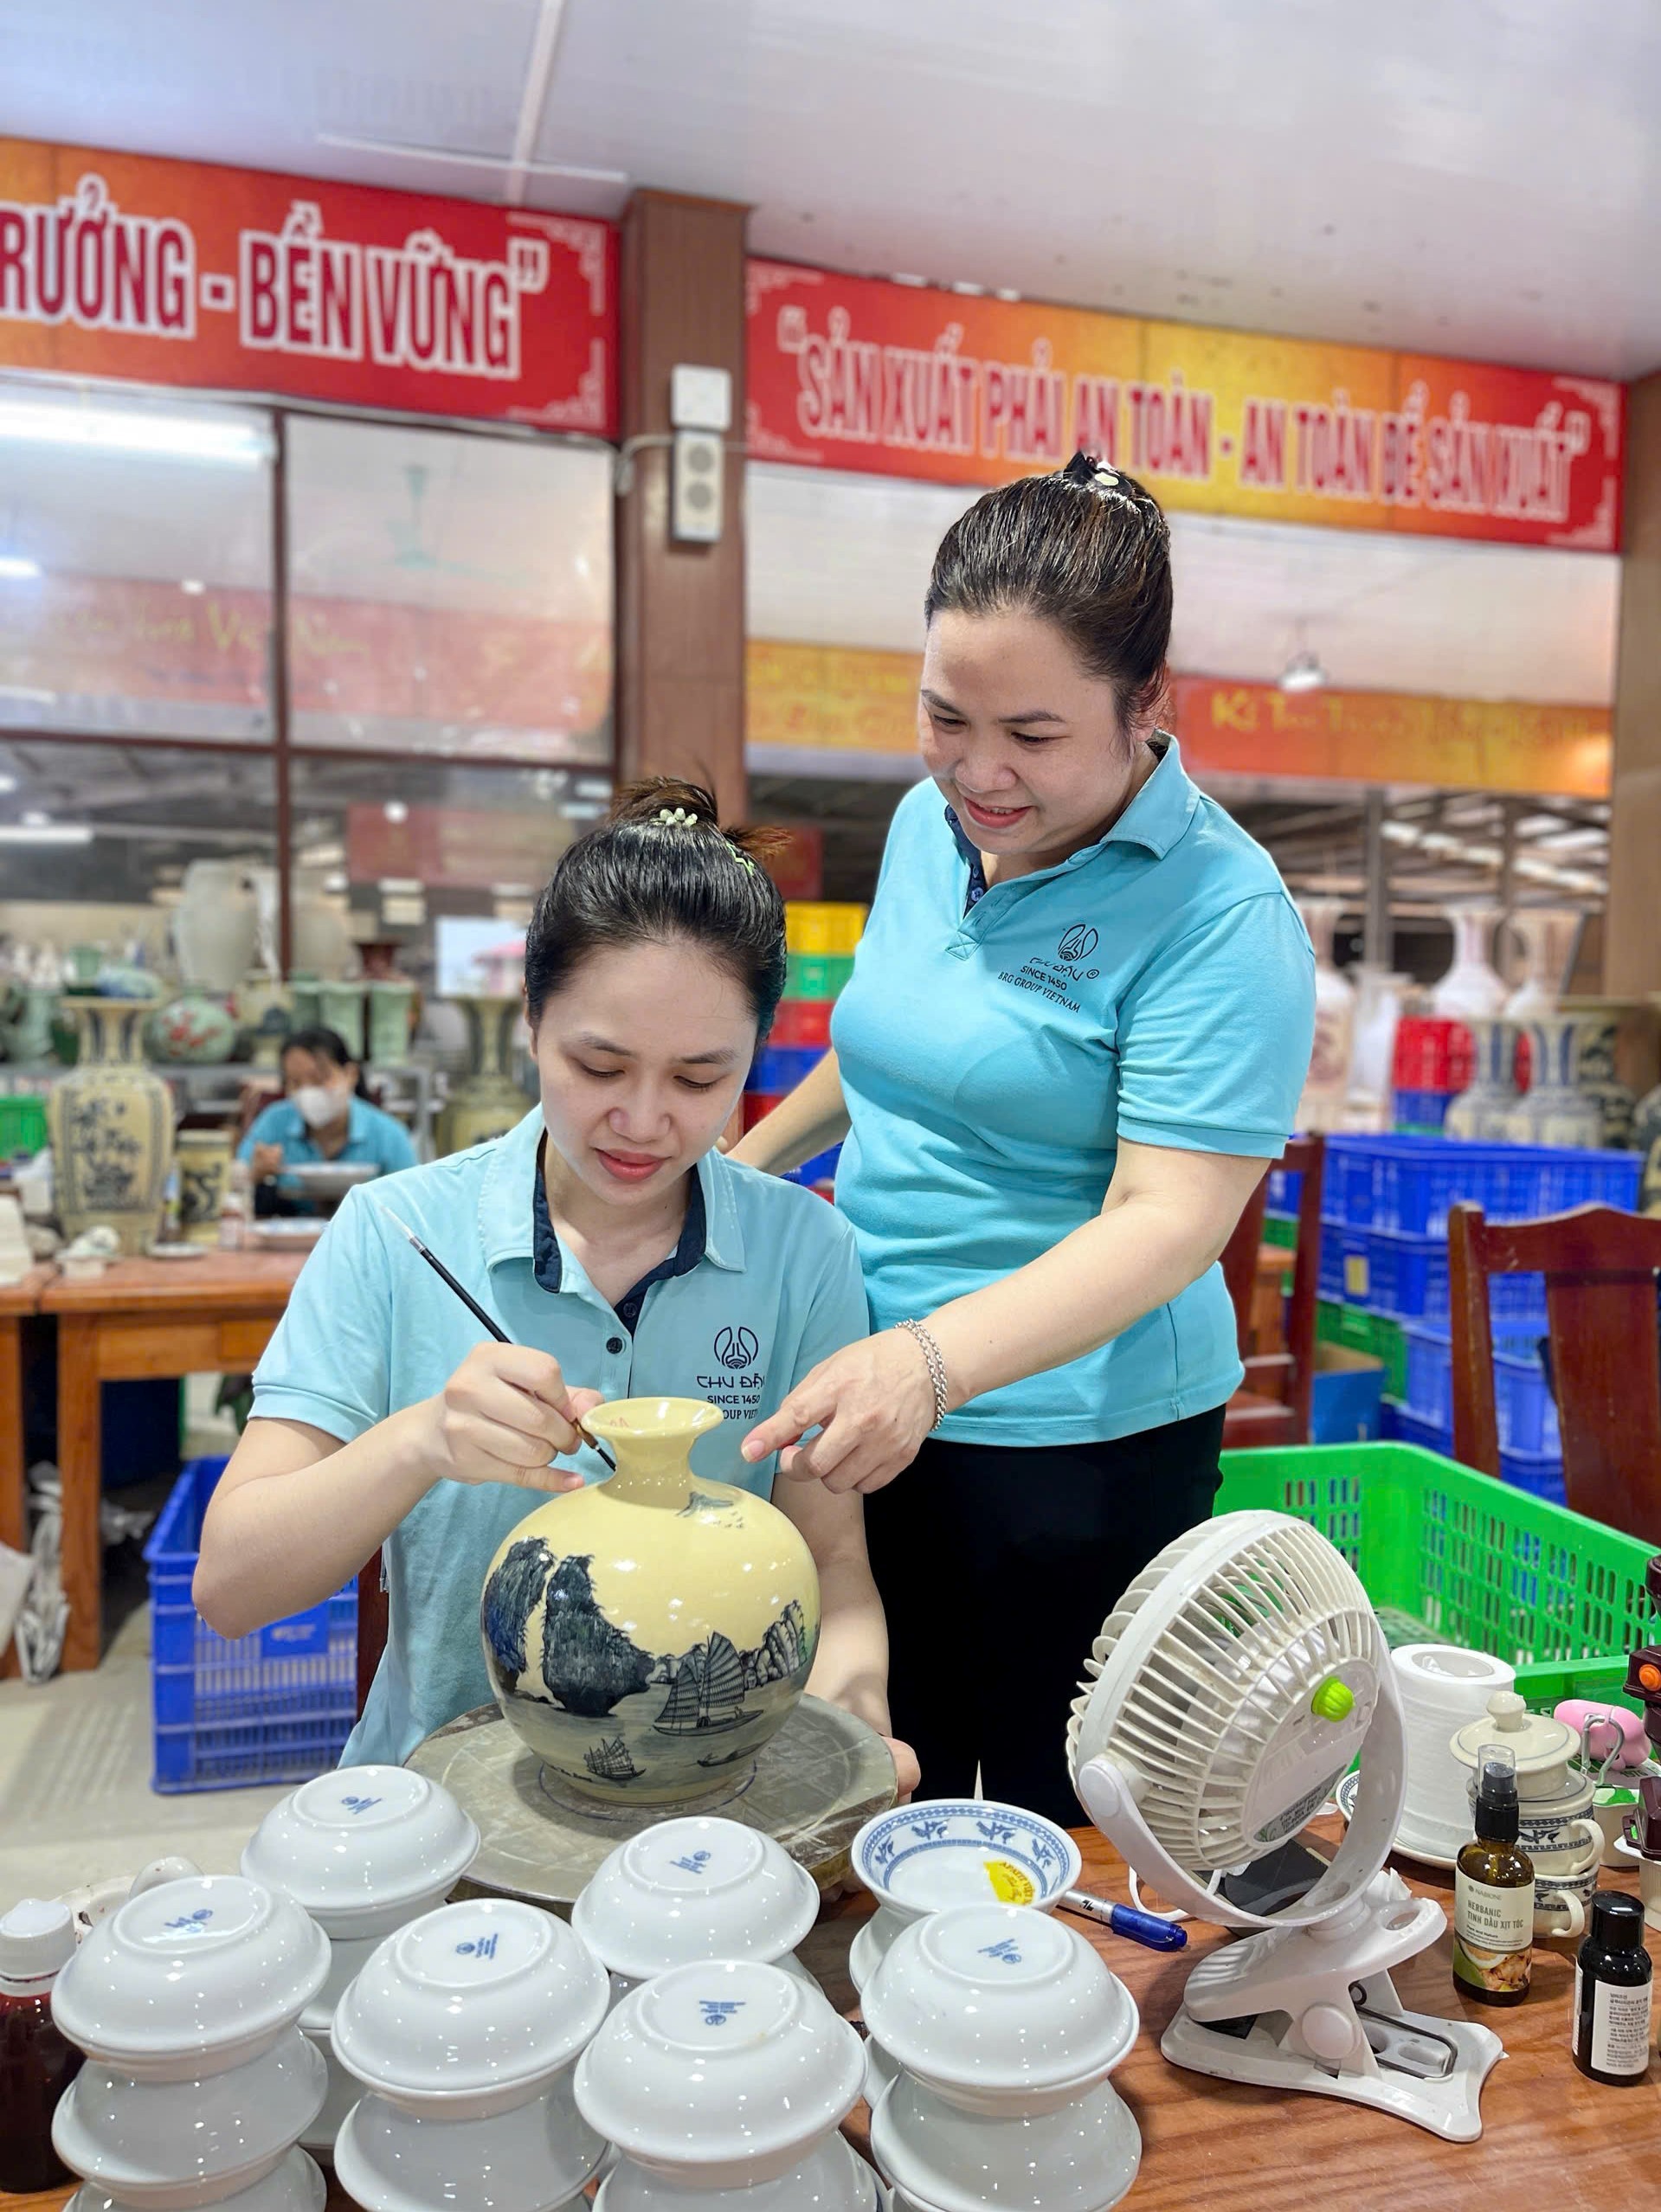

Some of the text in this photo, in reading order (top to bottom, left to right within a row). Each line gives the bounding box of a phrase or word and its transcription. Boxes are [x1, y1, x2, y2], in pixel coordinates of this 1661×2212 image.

[882, 321, 978, 457] XUẤT
[982, 338, 1066, 461] PHẢI
[1124, 367, 1216, 485] TOÀN
[1238, 395, 1288, 492] AN
[1291, 385, 1377, 501] TOÀN
[1426, 389, 1490, 514] SẢN
[1020, 965, 1068, 991] SINCE 1450
[998, 971, 1081, 1013] BRG GROUP VIETNAM
[696, 1375, 734, 1389] CHU
[706, 1394, 761, 1405] SINCE 1450
[1467, 1900, 1502, 1918] HERBANIC
[1467, 1910, 1482, 1925] TINH
[1484, 1916, 1498, 1929] DẦU
